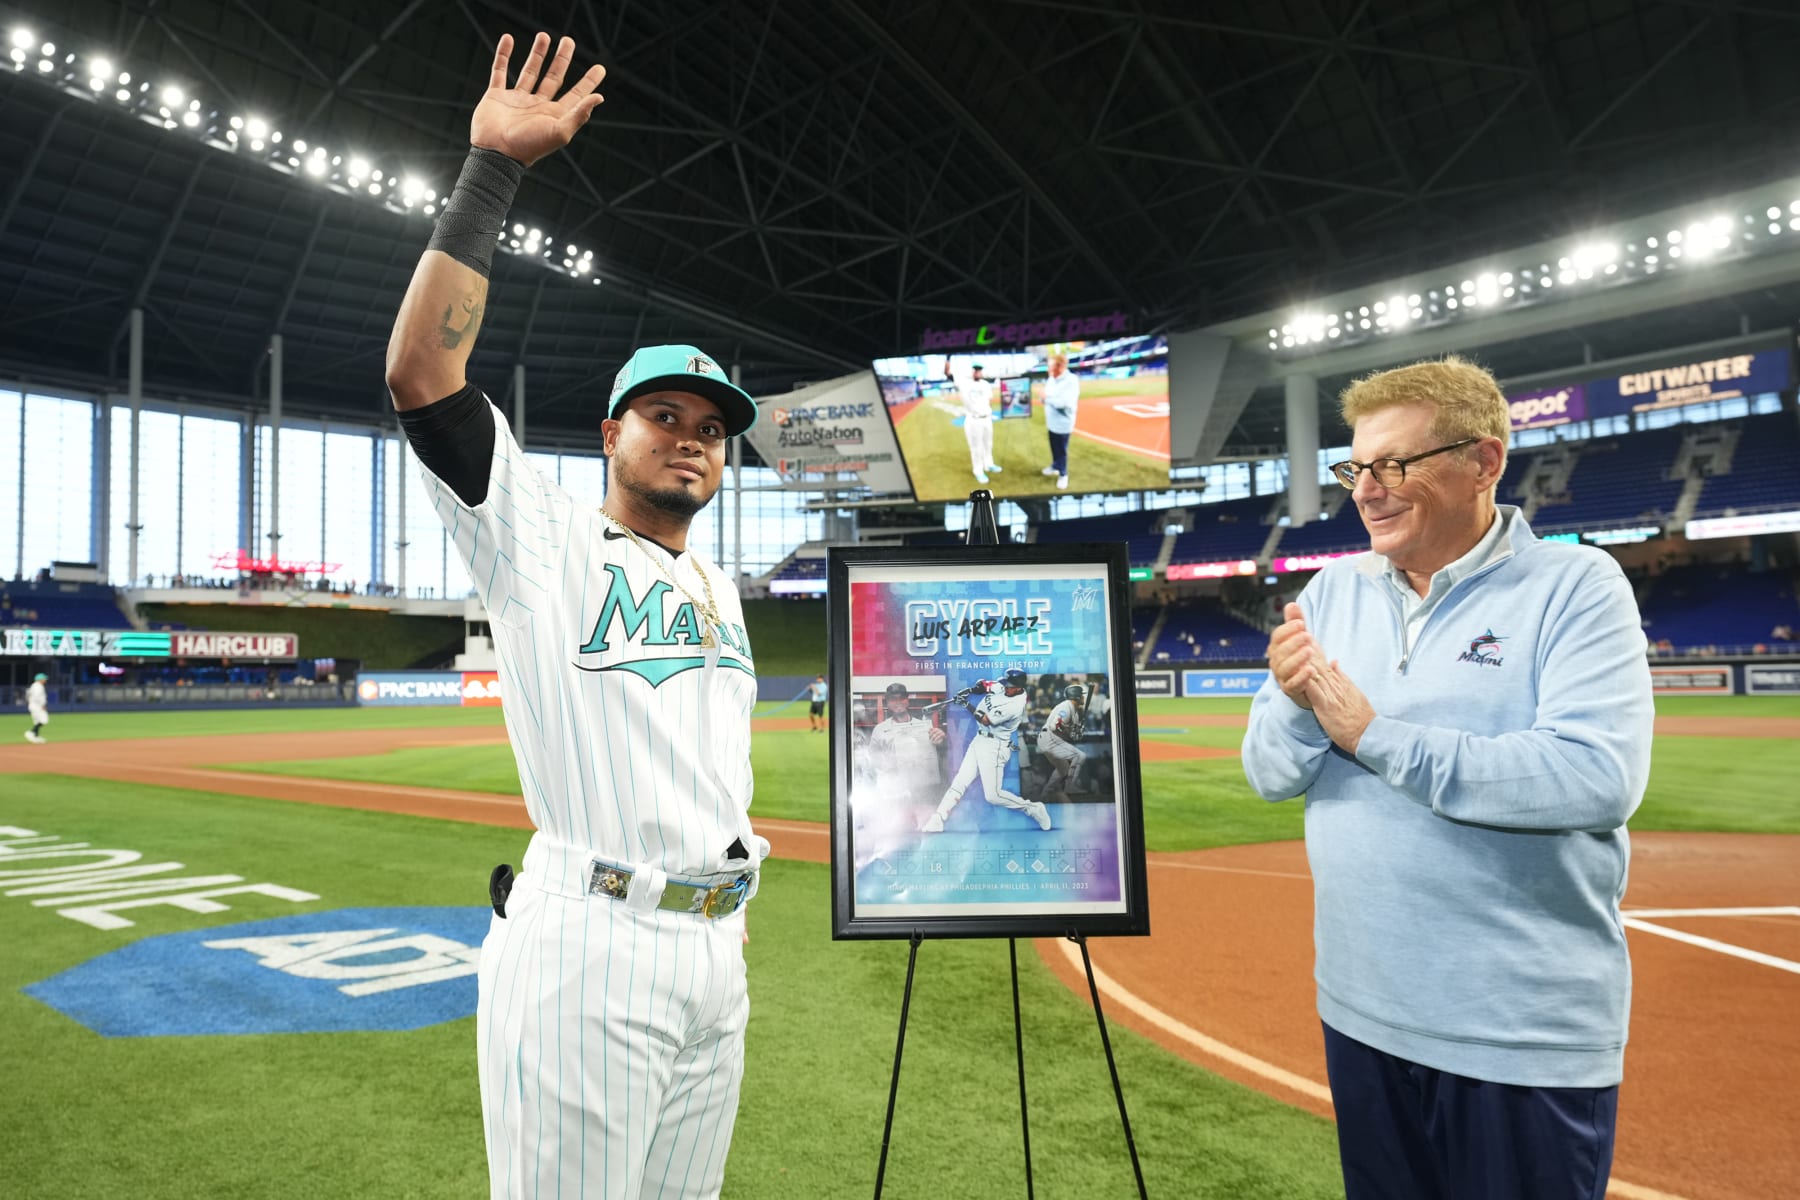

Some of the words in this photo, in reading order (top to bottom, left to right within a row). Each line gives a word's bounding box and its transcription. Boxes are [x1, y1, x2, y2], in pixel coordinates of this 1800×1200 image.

[1066, 312, 1126, 337] park
[1619, 355, 1752, 396] CUTWATER
[779, 426, 862, 442] AutoNation
[905, 598, 1053, 657] CYCLE
[913, 620, 950, 641] LUIS
[958, 616, 1039, 639] ARRAEZ
[178, 635, 287, 657] HAIRCLUB
[915, 662, 940, 670] FIRST
[956, 661, 1005, 669] FRANCHISE
[1008, 661, 1045, 669] HISTORY
